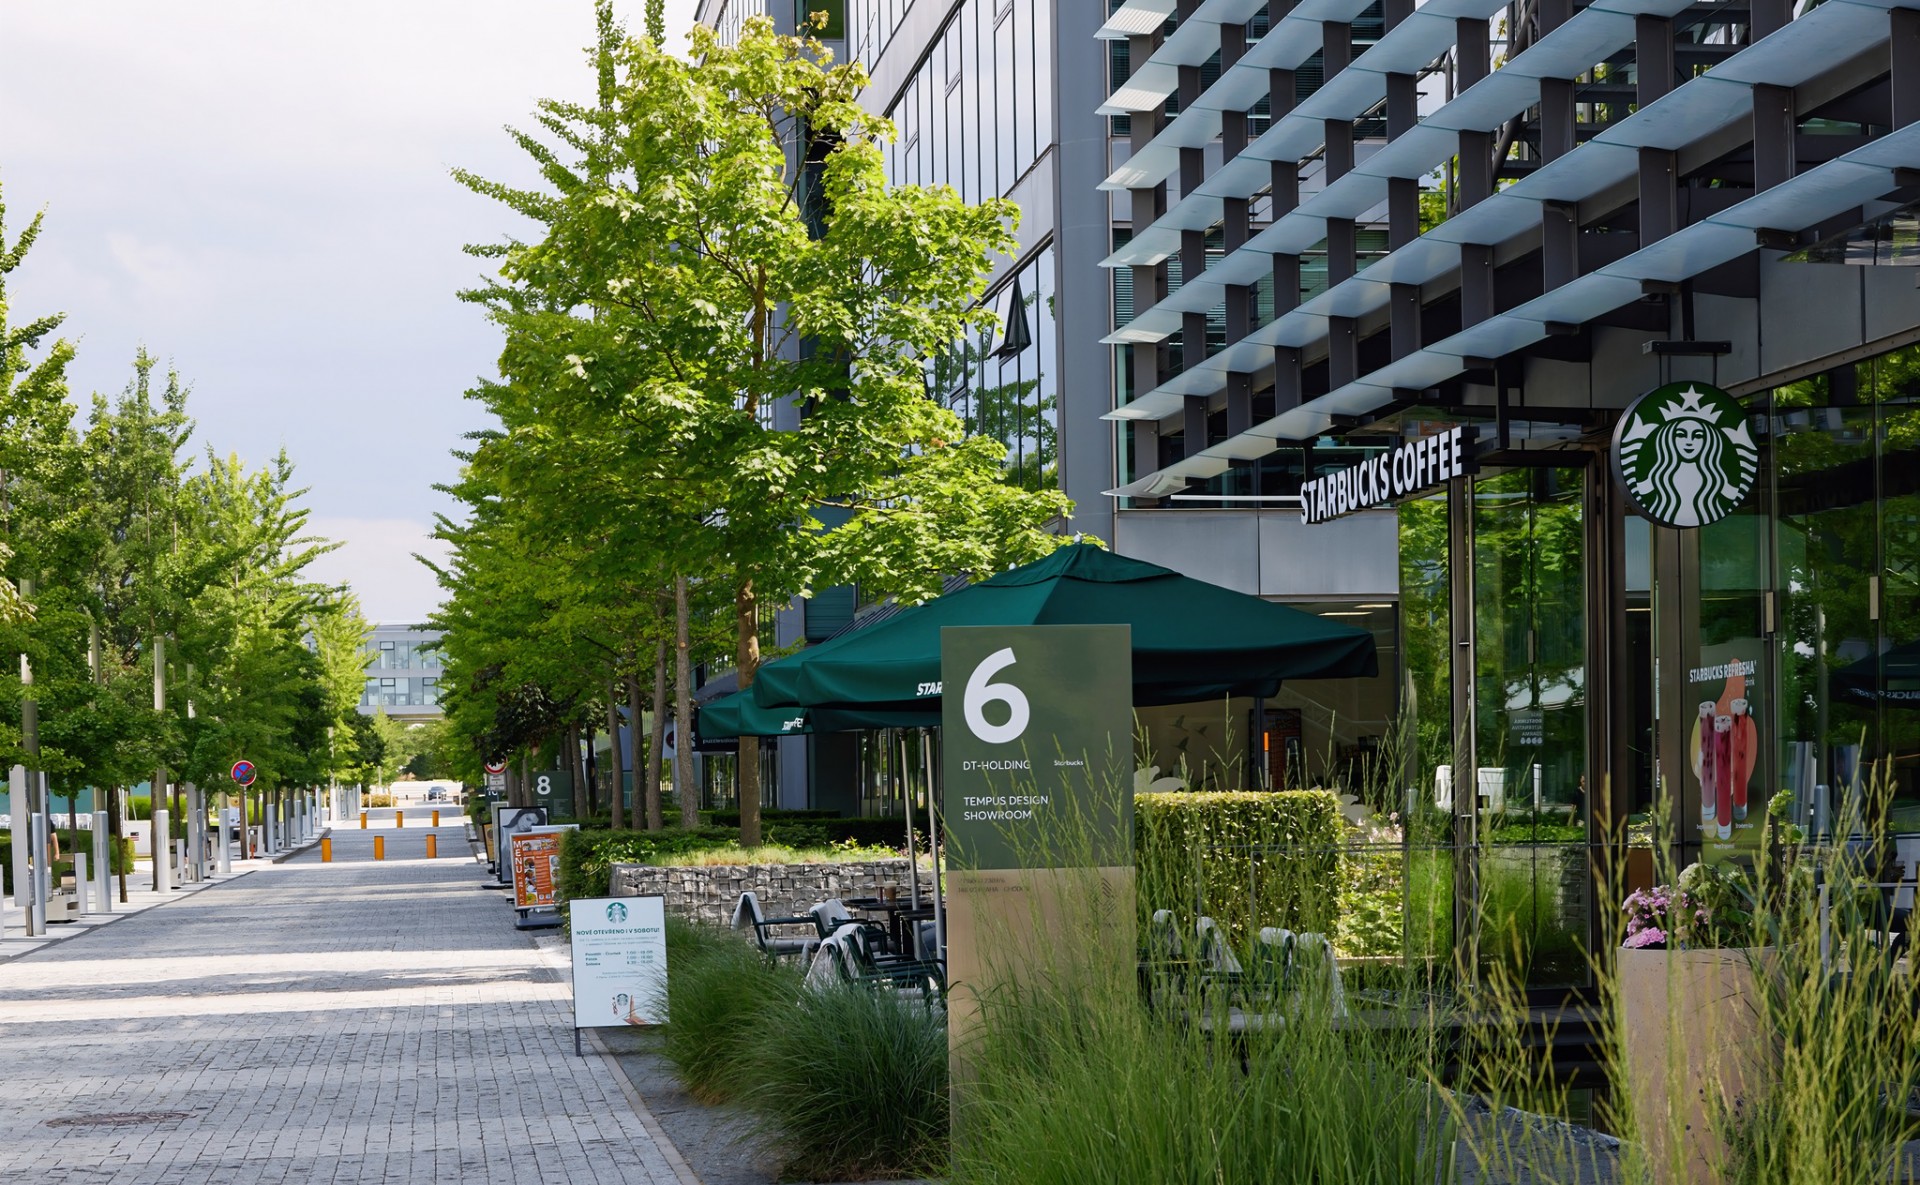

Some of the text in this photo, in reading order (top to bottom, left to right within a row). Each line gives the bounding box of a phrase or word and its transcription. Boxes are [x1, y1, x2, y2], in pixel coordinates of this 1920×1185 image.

[1300, 426, 1463, 525] STARBUCKS COFFEE
[1689, 664, 1723, 683] STARBUCKS
[963, 646, 1030, 744] 6
[962, 760, 1031, 771] DT-HOLDING
[536, 775, 551, 795] 8
[963, 795, 1049, 806] TEMPUS DESIGN
[963, 810, 1032, 820] SHOWROOM
[513, 840, 523, 873] MENU
